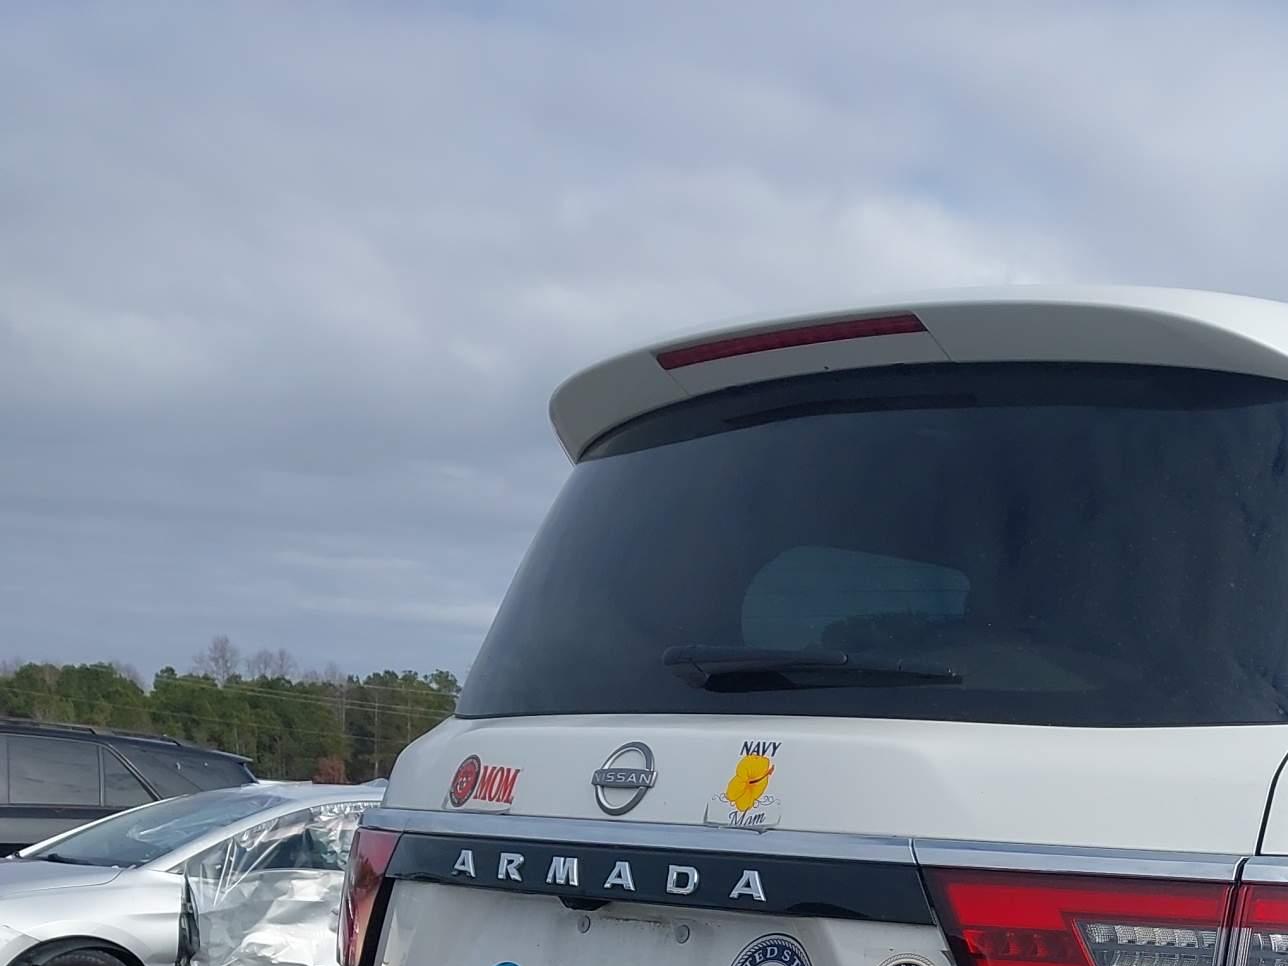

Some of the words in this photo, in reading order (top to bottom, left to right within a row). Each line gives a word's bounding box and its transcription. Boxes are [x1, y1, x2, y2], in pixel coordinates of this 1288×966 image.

[740, 741, 781, 757] NAVY
[472, 765, 521, 804] MOM
[593, 771, 652, 785] NISSAN
[451, 849, 767, 902] ARMADA
